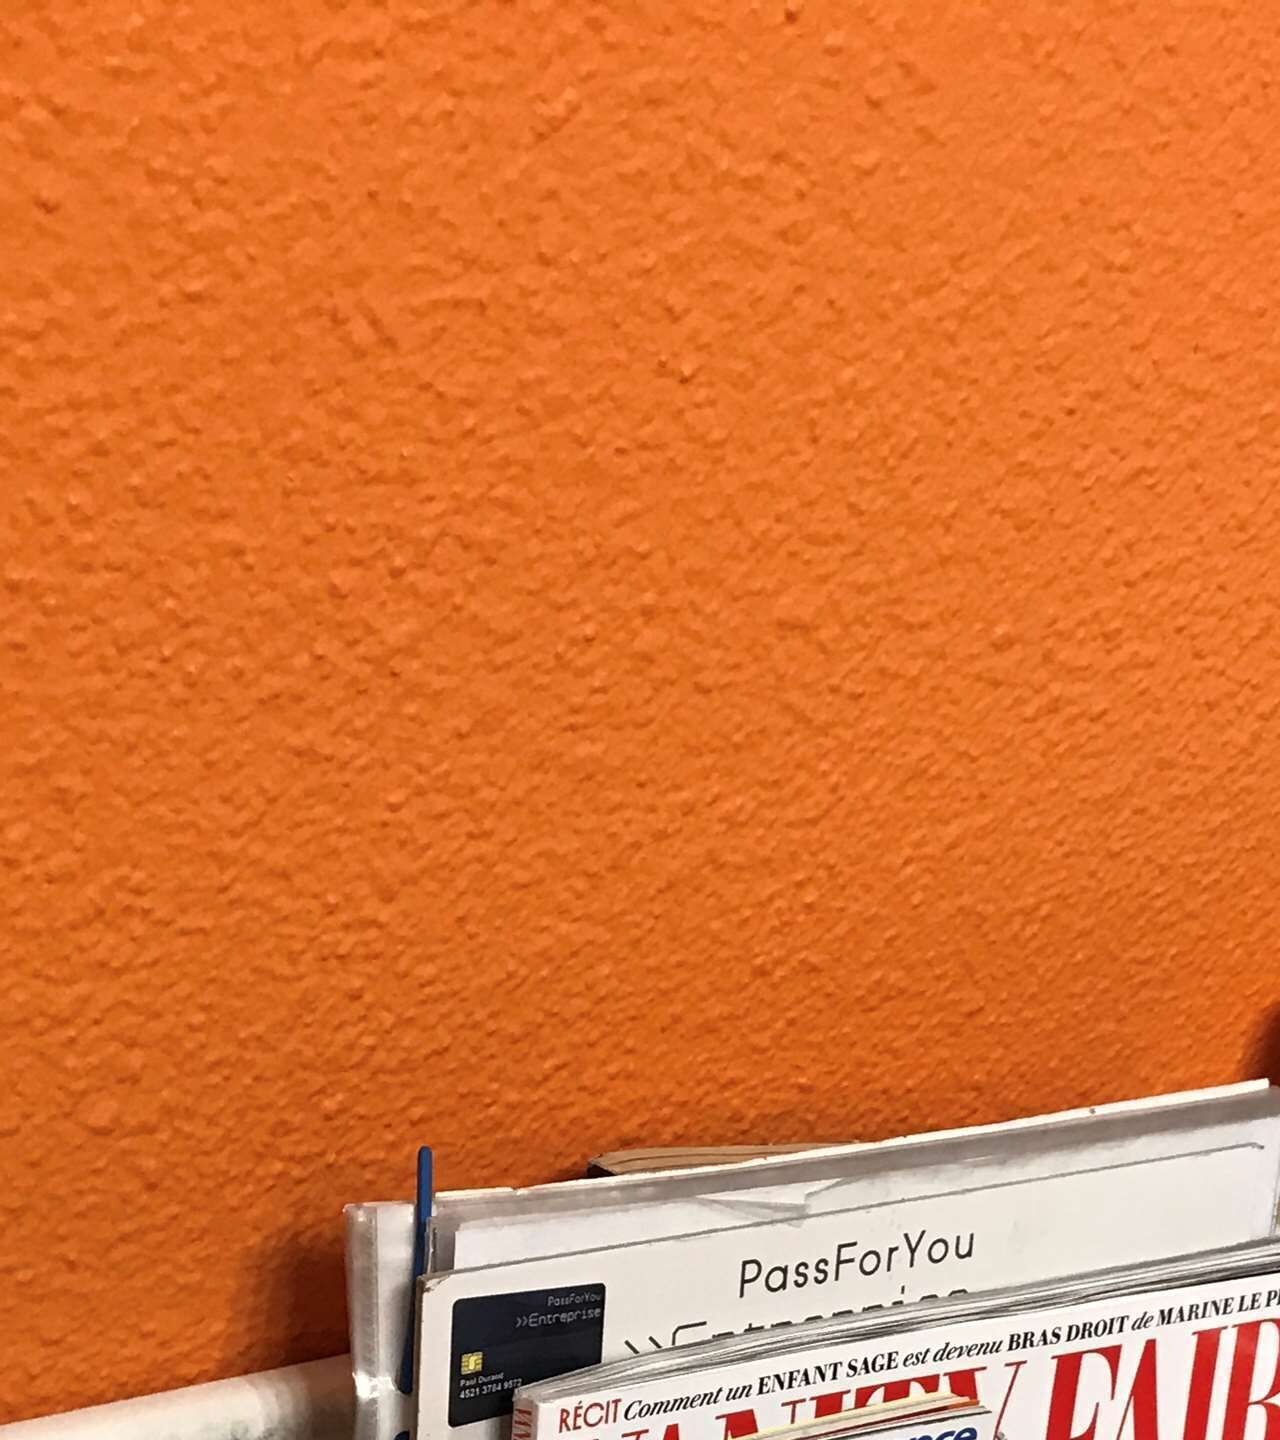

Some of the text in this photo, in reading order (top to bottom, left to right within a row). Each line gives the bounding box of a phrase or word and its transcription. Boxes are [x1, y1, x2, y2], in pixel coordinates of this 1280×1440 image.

[738, 1228, 974, 1297] PassForYou
[558, 1398, 621, 1434] RÉCIT
[623, 1386, 724, 1422] Comment
[725, 1384, 753, 1405] un
[756, 1362, 843, 1395] ENFANT
[845, 1350, 900, 1380] SAGE
[902, 1345, 931, 1368] est
[932, 1336, 1004, 1364] devenu
[1005, 1326, 1063, 1353] BRAS
[1064, 1314, 1129, 1344] DROIT
[1130, 1309, 1156, 1331] de
[1156, 1294, 1236, 1327] MARINE
[1236, 1290, 1264, 1313] LE
